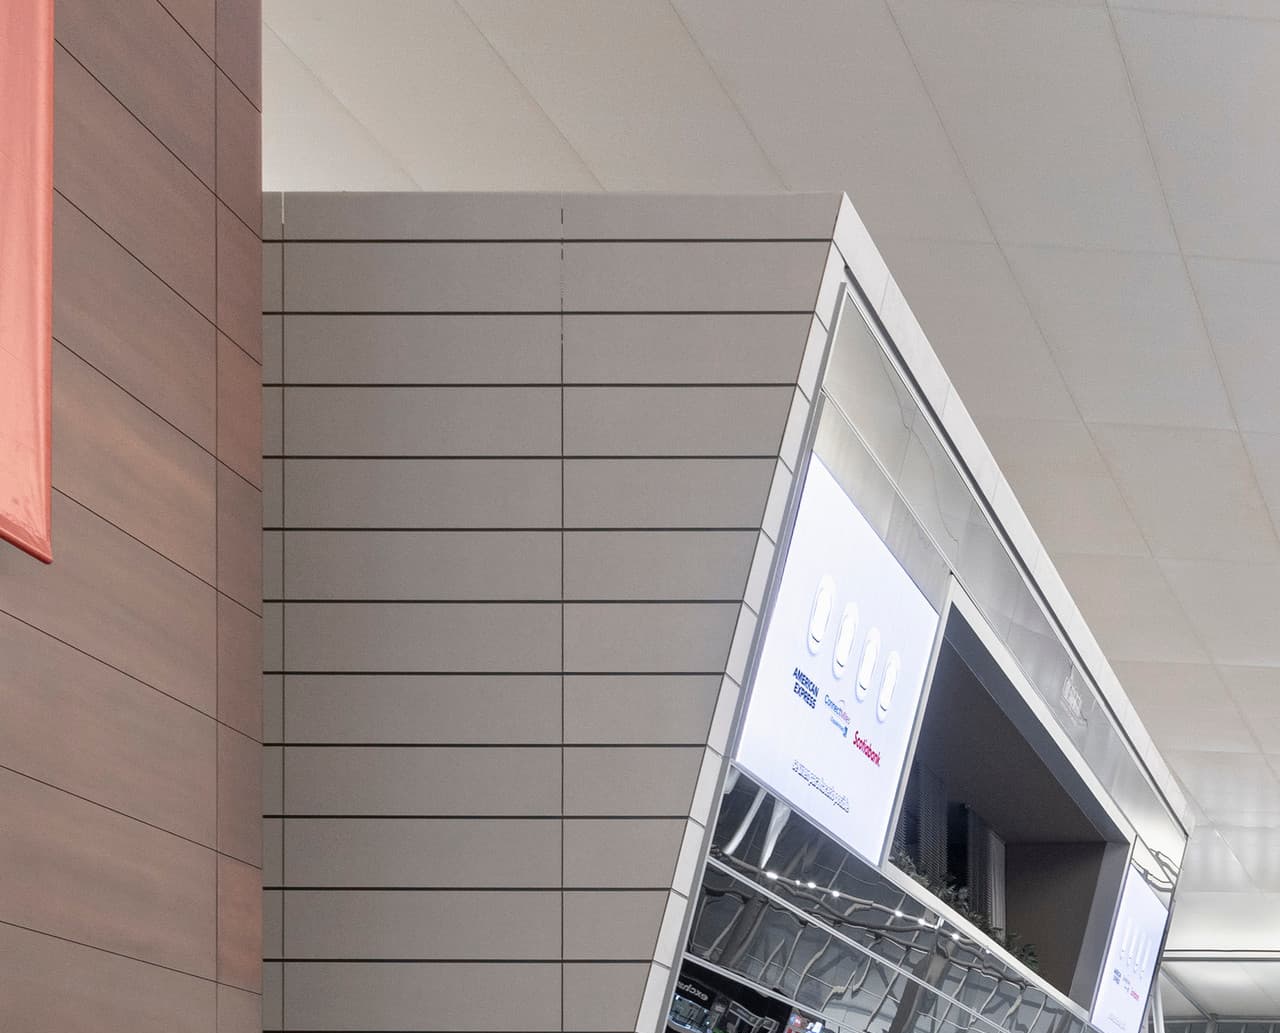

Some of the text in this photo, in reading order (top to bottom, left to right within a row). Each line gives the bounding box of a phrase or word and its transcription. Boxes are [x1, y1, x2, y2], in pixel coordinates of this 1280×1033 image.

[793, 667, 819, 697] AMERICAN
[793, 681, 816, 709] EXPRESS
[853, 730, 880, 767] Scotiabank
